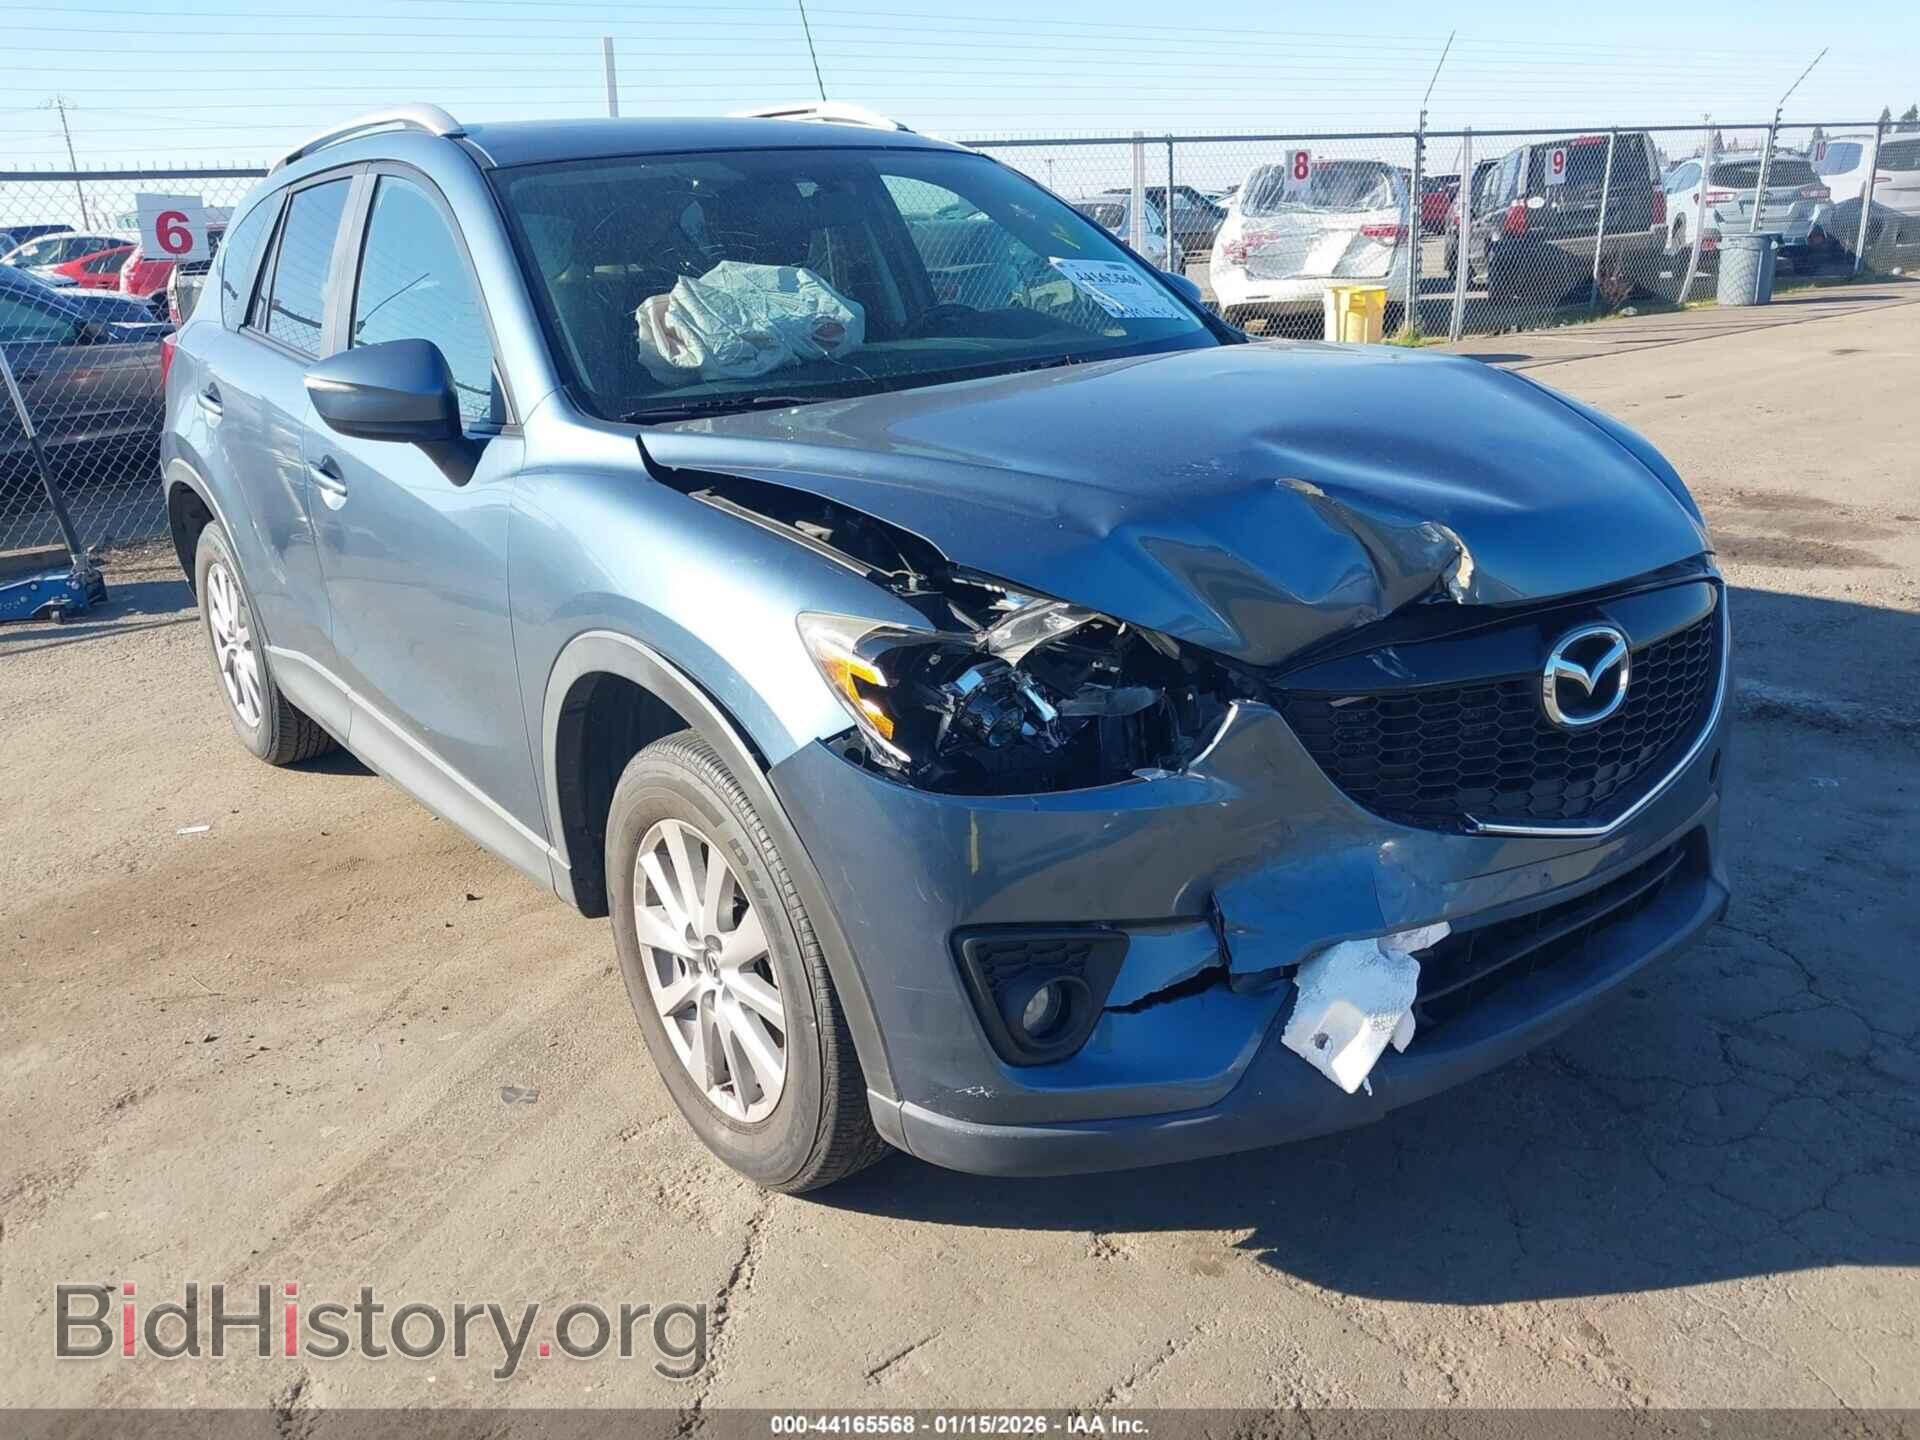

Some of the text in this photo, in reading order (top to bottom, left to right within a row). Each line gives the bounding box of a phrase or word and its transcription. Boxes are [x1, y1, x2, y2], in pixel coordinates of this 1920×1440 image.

[1294, 151, 1309, 180] 8
[1553, 150, 1564, 175] 9
[155, 210, 193, 254] 6
